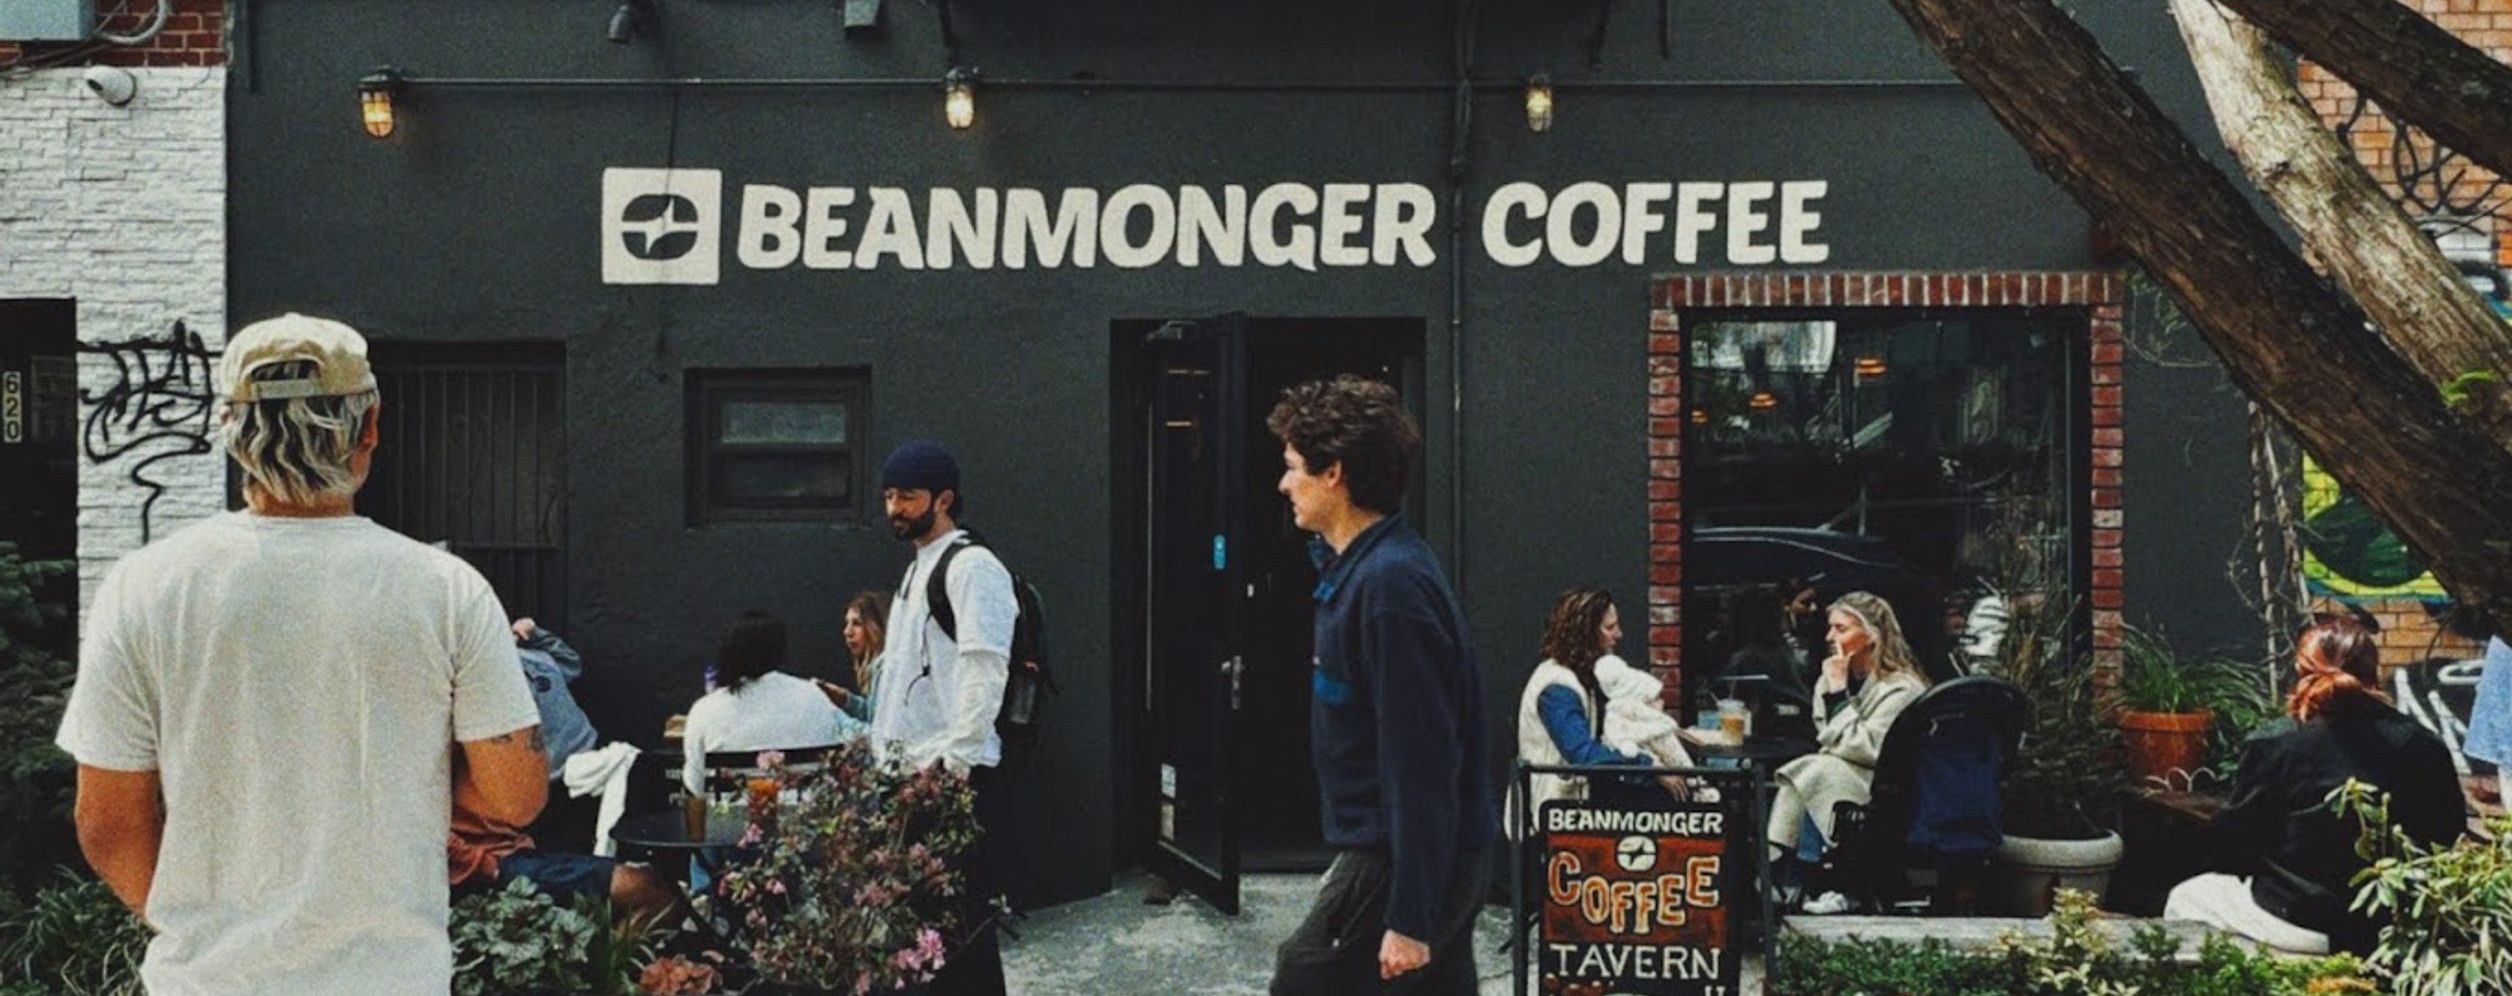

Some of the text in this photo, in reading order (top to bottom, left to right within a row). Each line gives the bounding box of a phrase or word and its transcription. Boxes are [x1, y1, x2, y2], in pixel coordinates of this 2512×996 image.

[737, 180, 1829, 271] BEANMONGER COFFEE
[4, 373, 20, 440] 620
[1548, 808, 1723, 836] BEANMONGER
[1548, 851, 1719, 933] COFFEE
[1549, 943, 1720, 979] TAVERN
